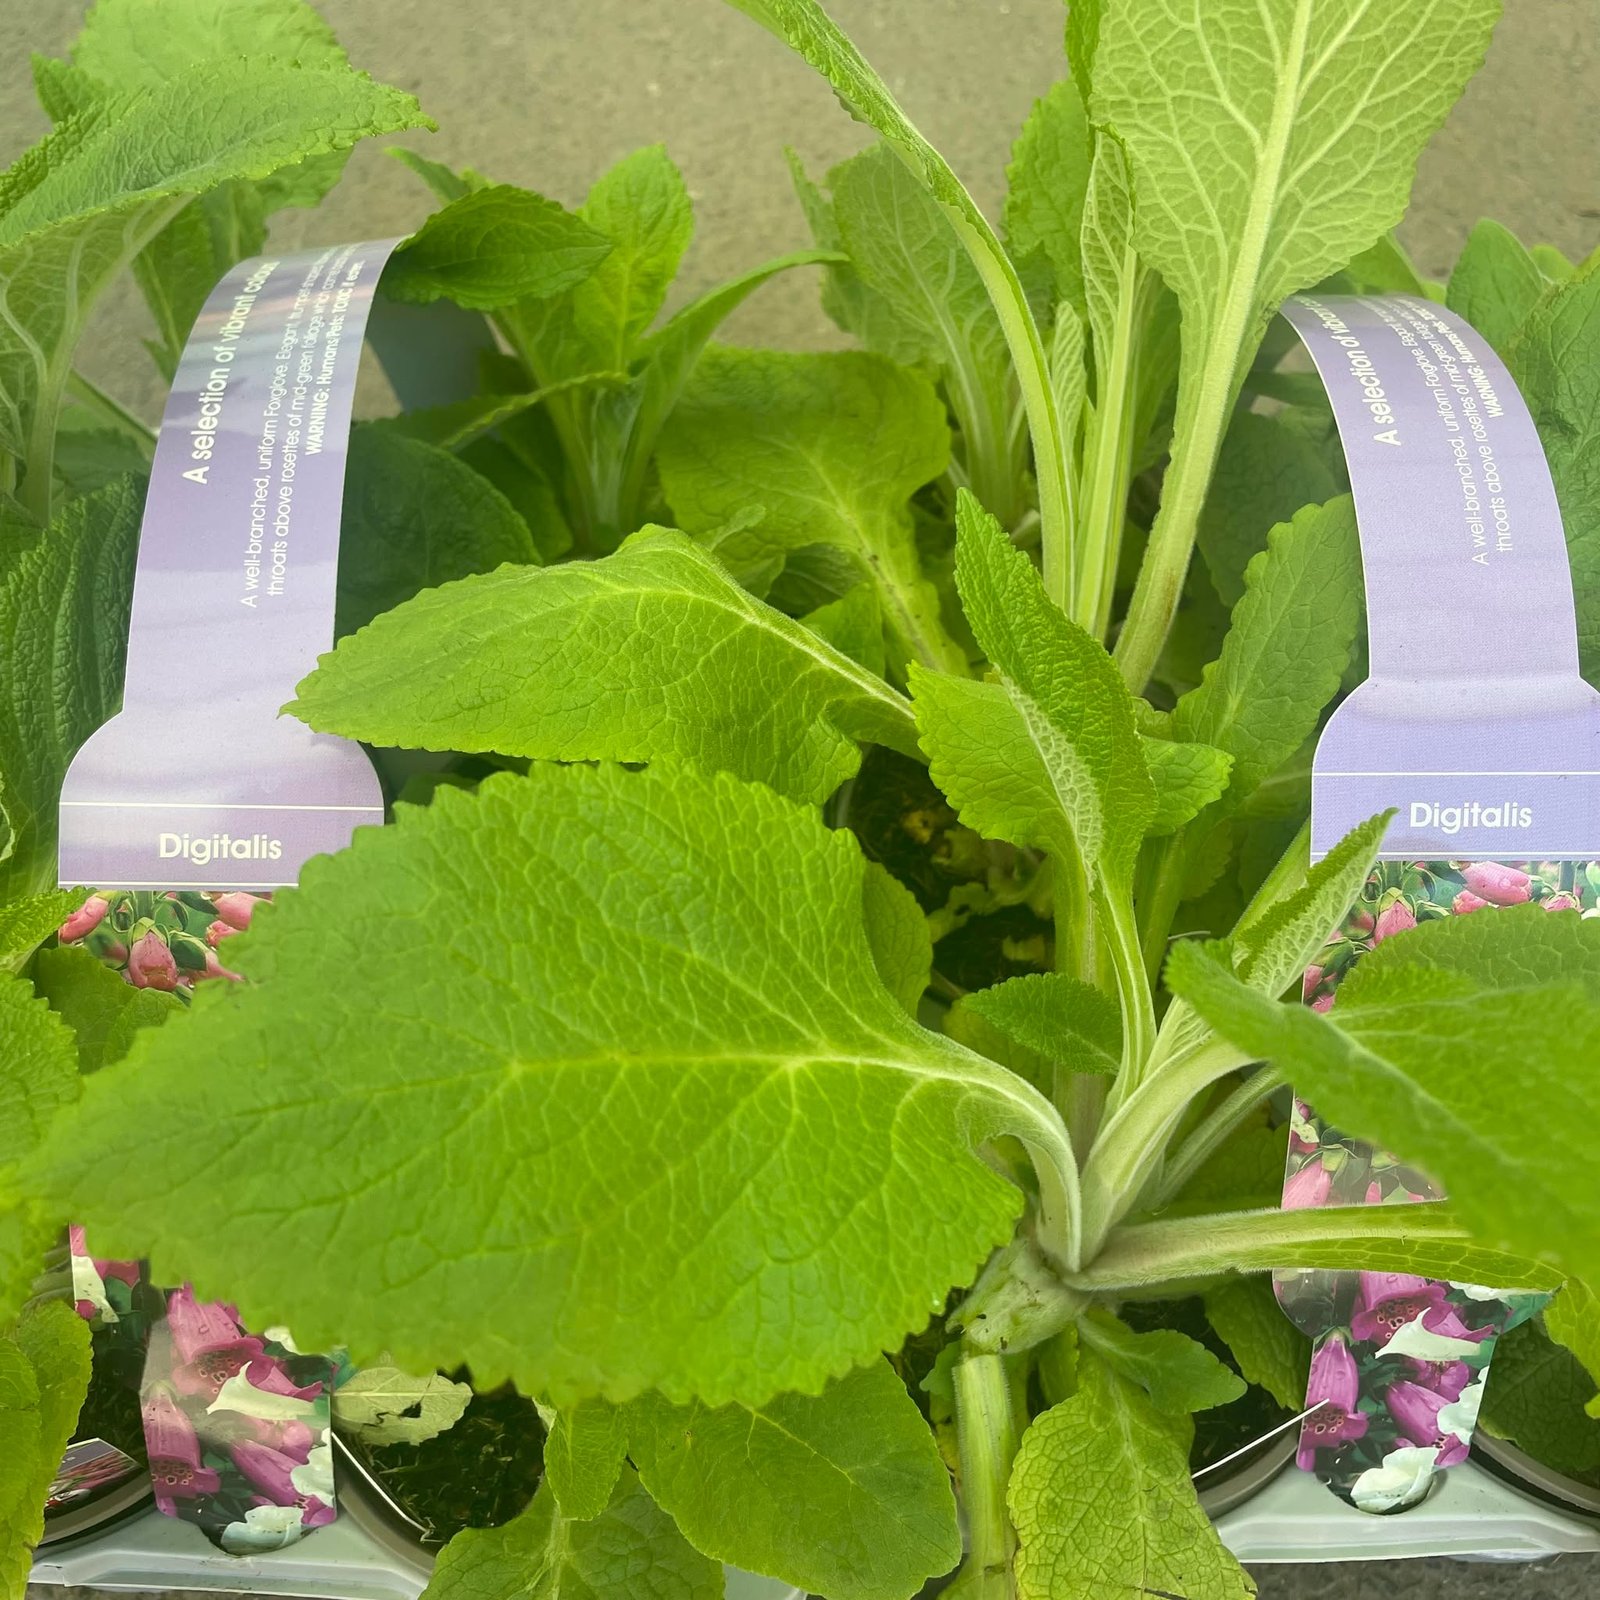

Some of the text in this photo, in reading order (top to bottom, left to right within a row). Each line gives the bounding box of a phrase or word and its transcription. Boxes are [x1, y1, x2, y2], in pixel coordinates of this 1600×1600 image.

[220, 295, 256, 342] vibrant
[302, 316, 324, 348] foliage
[1306, 307, 1350, 334] vibrant
[1331, 335, 1360, 347] of
[213, 346, 236, 363] of
[1428, 340, 1464, 382] mid-green
[264, 363, 287, 416] Foxglove.
[291, 351, 313, 410] mid-green
[1346, 350, 1395, 424] selection
[1451, 384, 1469, 395] of
[1467, 365, 1505, 418] WARNING:
[191, 369, 230, 461] selection
[287, 414, 303, 427] of
[305, 388, 330, 455] WARNING:
[1433, 389, 1460, 431] uniform
[1461, 397, 1488, 442] rosettes
[257, 420, 278, 470] uniform
[281, 430, 300, 482] rosettes
[1373, 430, 1401, 446] A
[183, 466, 209, 485] A
[1447, 436, 1486, 548] well-branched,
[1478, 446, 1500, 493] above
[244, 475, 271, 590] well-branched,
[273, 487, 293, 536] above
[1489, 497, 1513, 552] throats
[267, 541, 287, 596] throats
[1472, 552, 1489, 565] A
[240, 595, 258, 608] A
[1410, 802, 1532, 834] Digitalis
[158, 833, 282, 865] Digitalis
